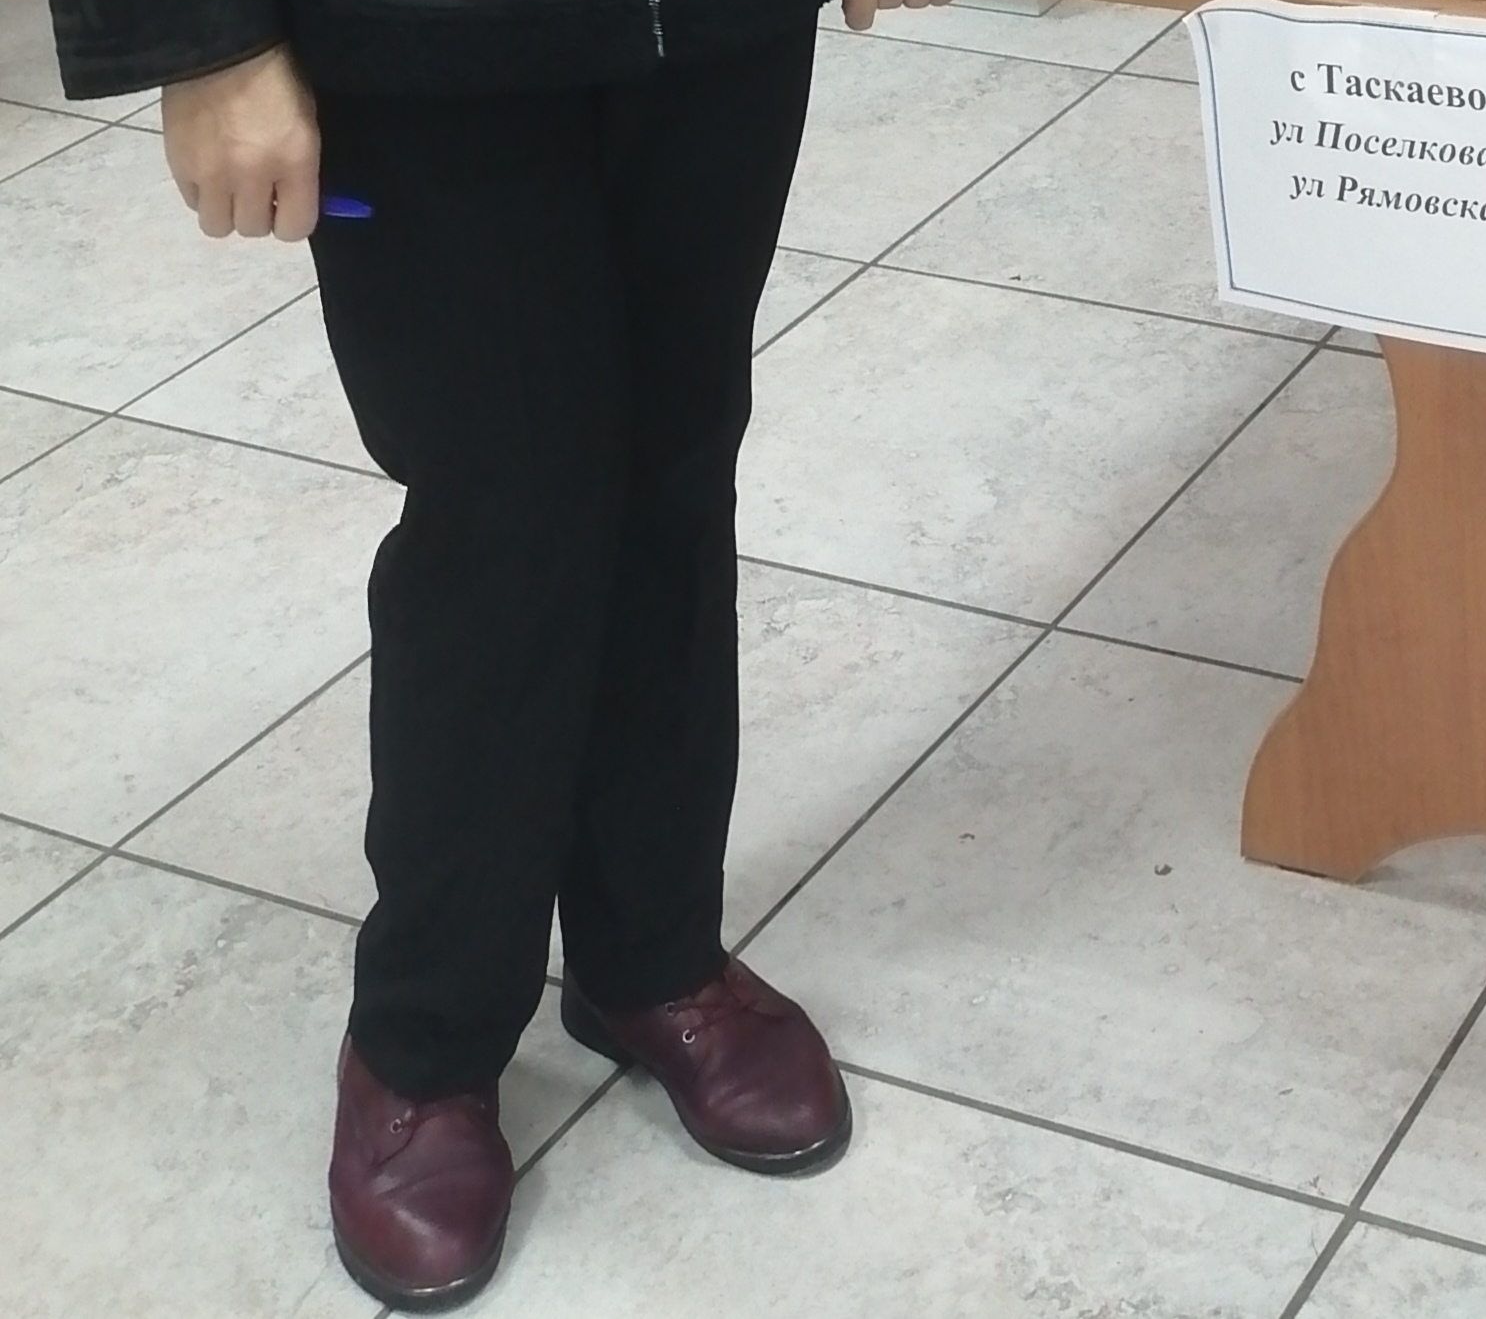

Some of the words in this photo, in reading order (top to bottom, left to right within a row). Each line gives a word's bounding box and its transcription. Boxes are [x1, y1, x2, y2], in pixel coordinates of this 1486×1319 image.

[1289, 68, 1306, 93] с
[1269, 119, 1305, 146] ул
[1289, 173, 1326, 201] ул
